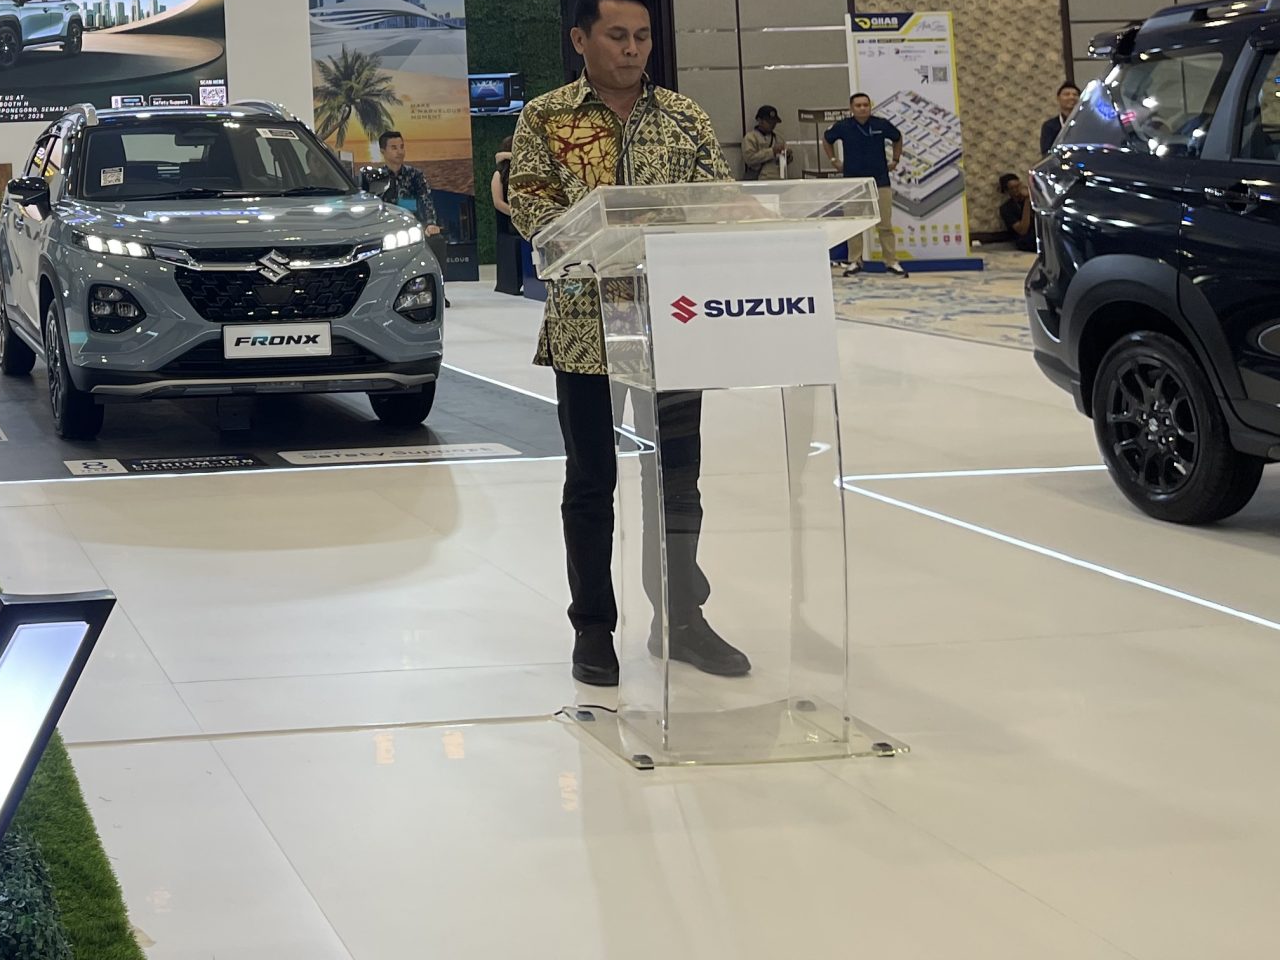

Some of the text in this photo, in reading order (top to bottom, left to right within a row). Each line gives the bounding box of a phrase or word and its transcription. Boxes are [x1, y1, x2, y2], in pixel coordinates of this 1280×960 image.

[703, 296, 816, 318] SUZUKI
[234, 334, 321, 347] FRONX
[302, 451, 385, 459] Safety
[131, 458, 255, 469] LITHIUM-ION
